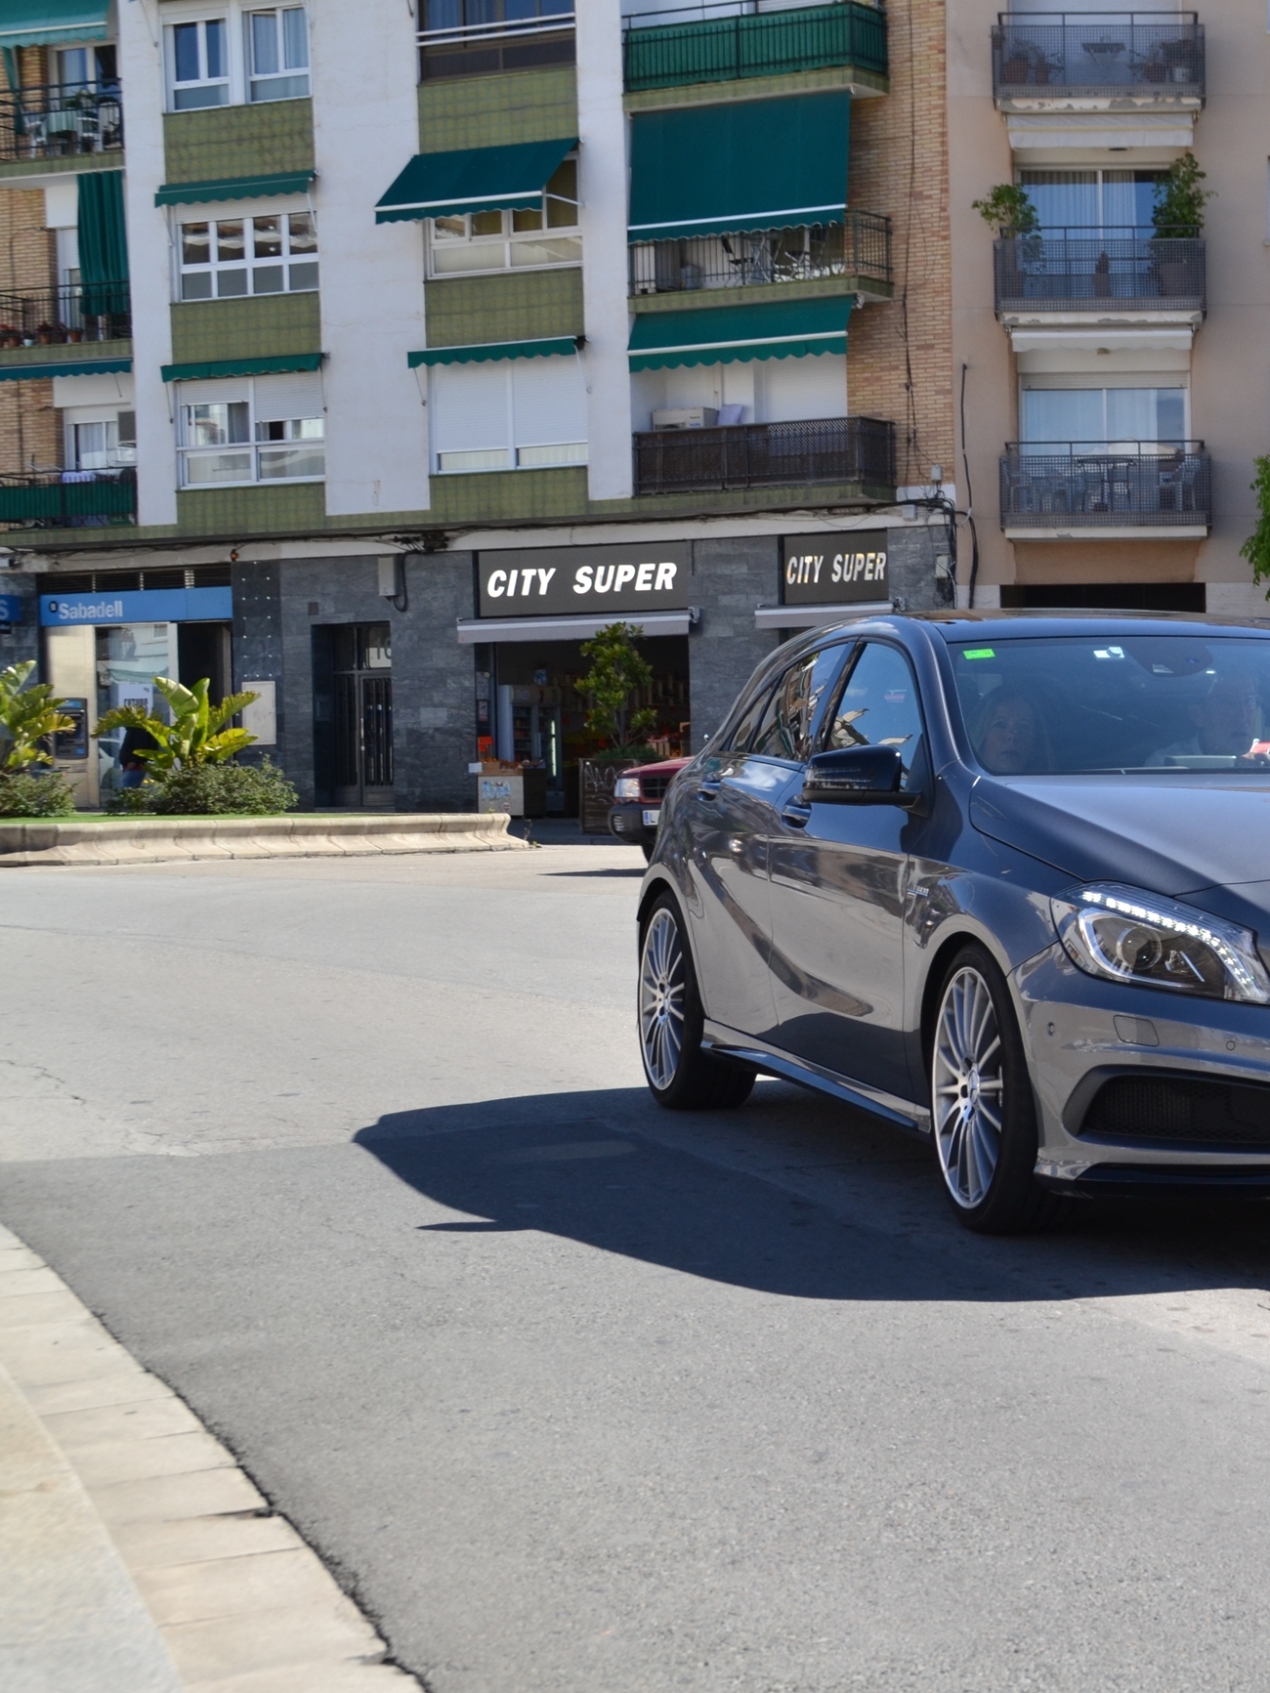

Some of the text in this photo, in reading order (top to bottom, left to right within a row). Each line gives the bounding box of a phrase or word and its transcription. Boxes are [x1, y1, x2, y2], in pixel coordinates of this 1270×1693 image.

[487, 562, 677, 598] CITY SUPER
[786, 551, 887, 585] CITY SUPER
[58, 600, 123, 619] Sabadell
